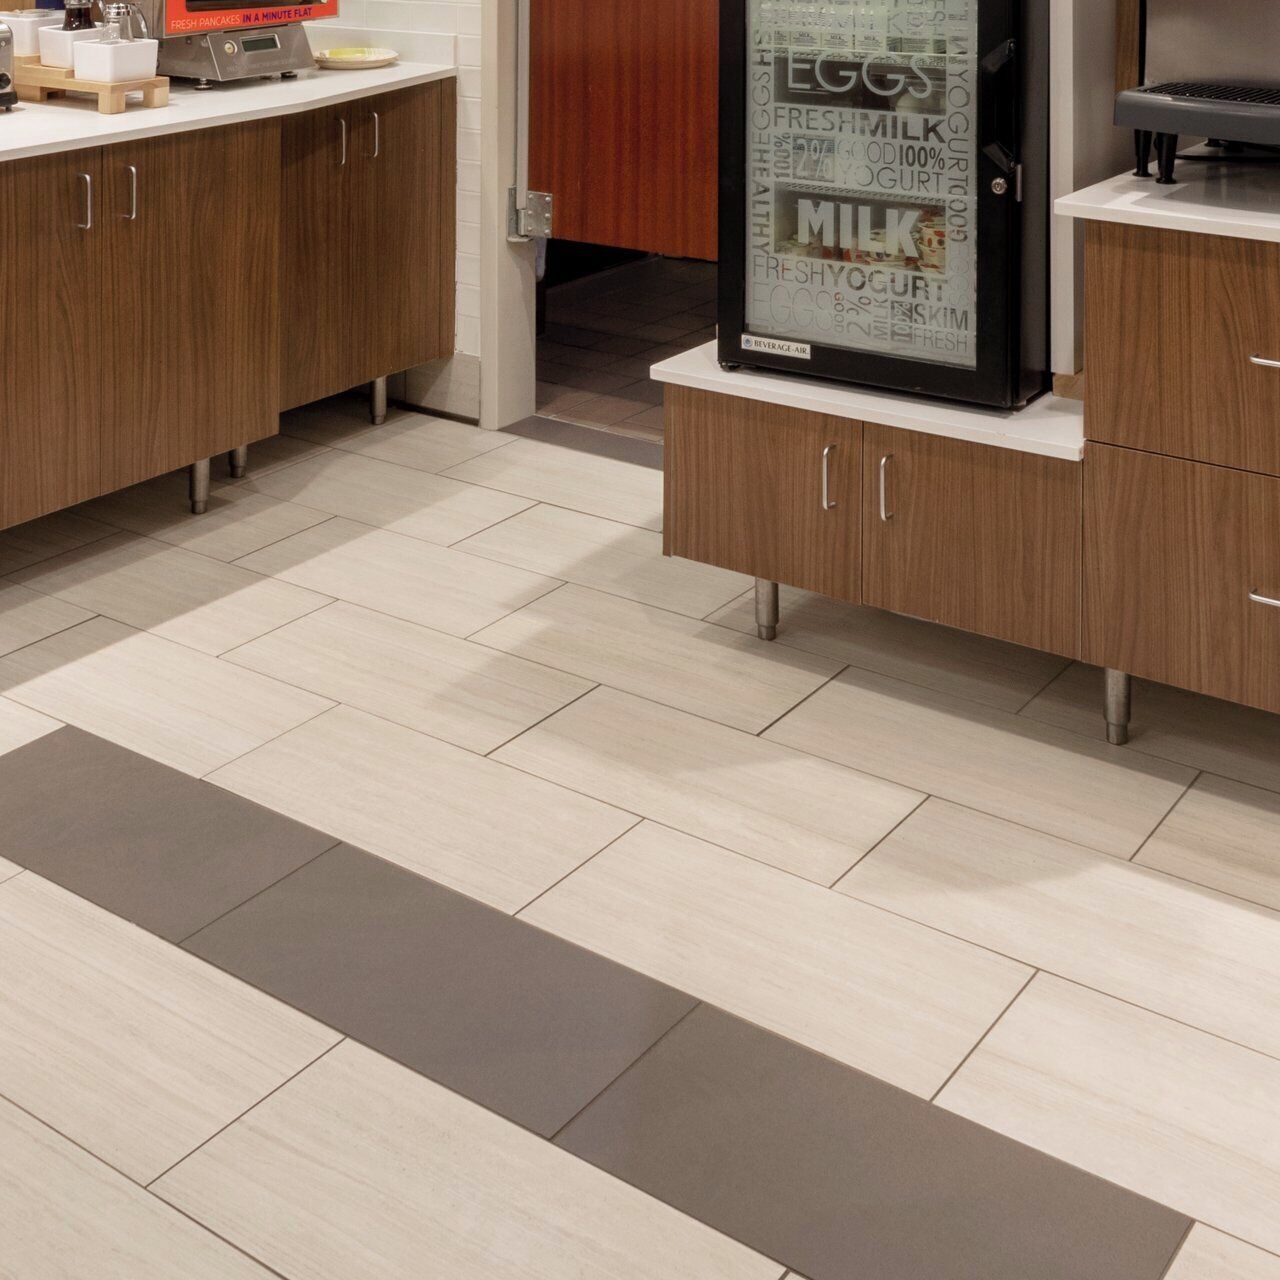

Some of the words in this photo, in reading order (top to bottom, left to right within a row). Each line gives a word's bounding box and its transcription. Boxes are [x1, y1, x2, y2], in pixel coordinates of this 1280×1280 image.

[171, 20, 197, 30] FRESH
[200, 14, 241, 27] PANCAKES
[243, 14, 252, 23] IN
[255, 14, 260, 22] A
[263, 10, 292, 20] MINUTE
[294, 7, 313, 17] FLAT
[788, 51, 933, 99] EGGS
[774, 107, 856, 136] FRESH
[859, 112, 947, 144] MILK
[899, 144, 945, 171] 100%
[838, 164, 945, 195] YOGURT
[752, 148, 770, 256] HEALTHY
[797, 198, 921, 258] MILK
[753, 255, 825, 287] FRESH
[826, 264, 948, 302] YOGURT
[753, 282, 833, 333] EGGS
[913, 327, 967, 353] FRESH
